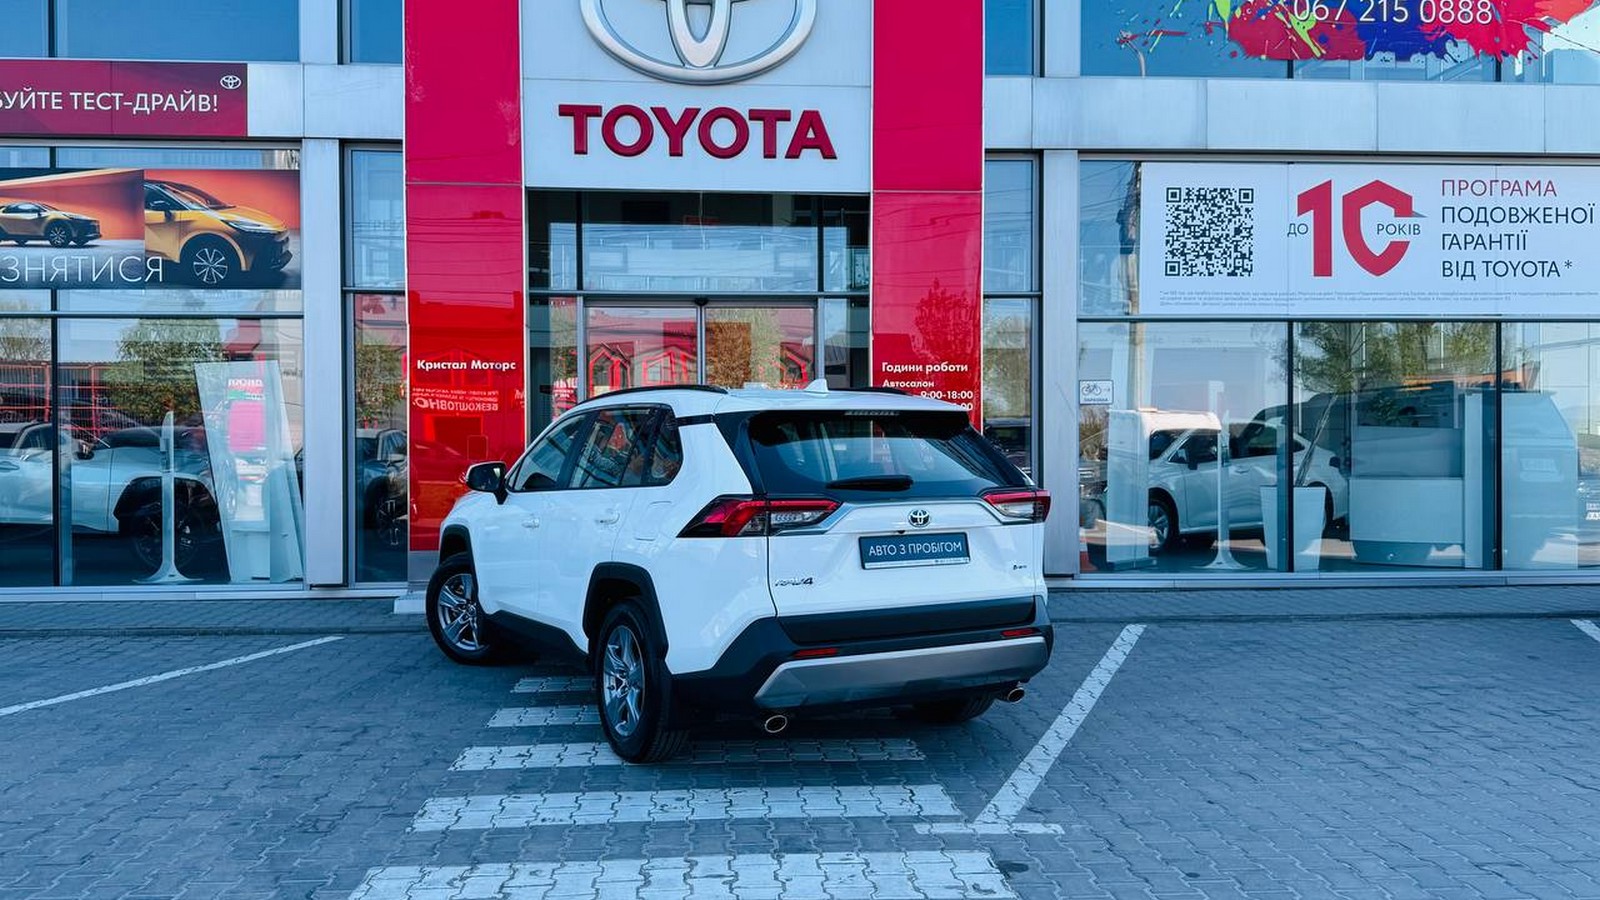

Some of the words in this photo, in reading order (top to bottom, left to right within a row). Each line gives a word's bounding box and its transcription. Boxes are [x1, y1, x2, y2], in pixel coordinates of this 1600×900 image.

[1359, 0, 1409, 22] 215
[1420, 0, 1493, 24] 0888
[0, 87, 63, 110] УЙТЕ
[69, 90, 218, 114] ТЕСТ-ДРАЙВ!
[558, 104, 838, 160] TOYOTA
[1441, 179, 1557, 197] ПРОГРАМА
[1441, 203, 1594, 227] ПОДОВЖЕНОЇ
[1287, 223, 1309, 237] ДО
[1377, 223, 1421, 236] РОКІВ
[1441, 229, 1528, 251] ГАРАНТІЇ
[1, 255, 163, 283] ЗНЯТИСЯ
[1441, 260, 1476, 281] ВІД
[417, 360, 467, 372] Кристал
[471, 360, 516, 372] Моторс
[882, 362, 923, 373] Години
[926, 361, 968, 374] роботи
[882, 379, 935, 388] Автосалон
[869, 544, 897, 556] АВТО
[908, 541, 962, 554] ПРОБІГОМ
